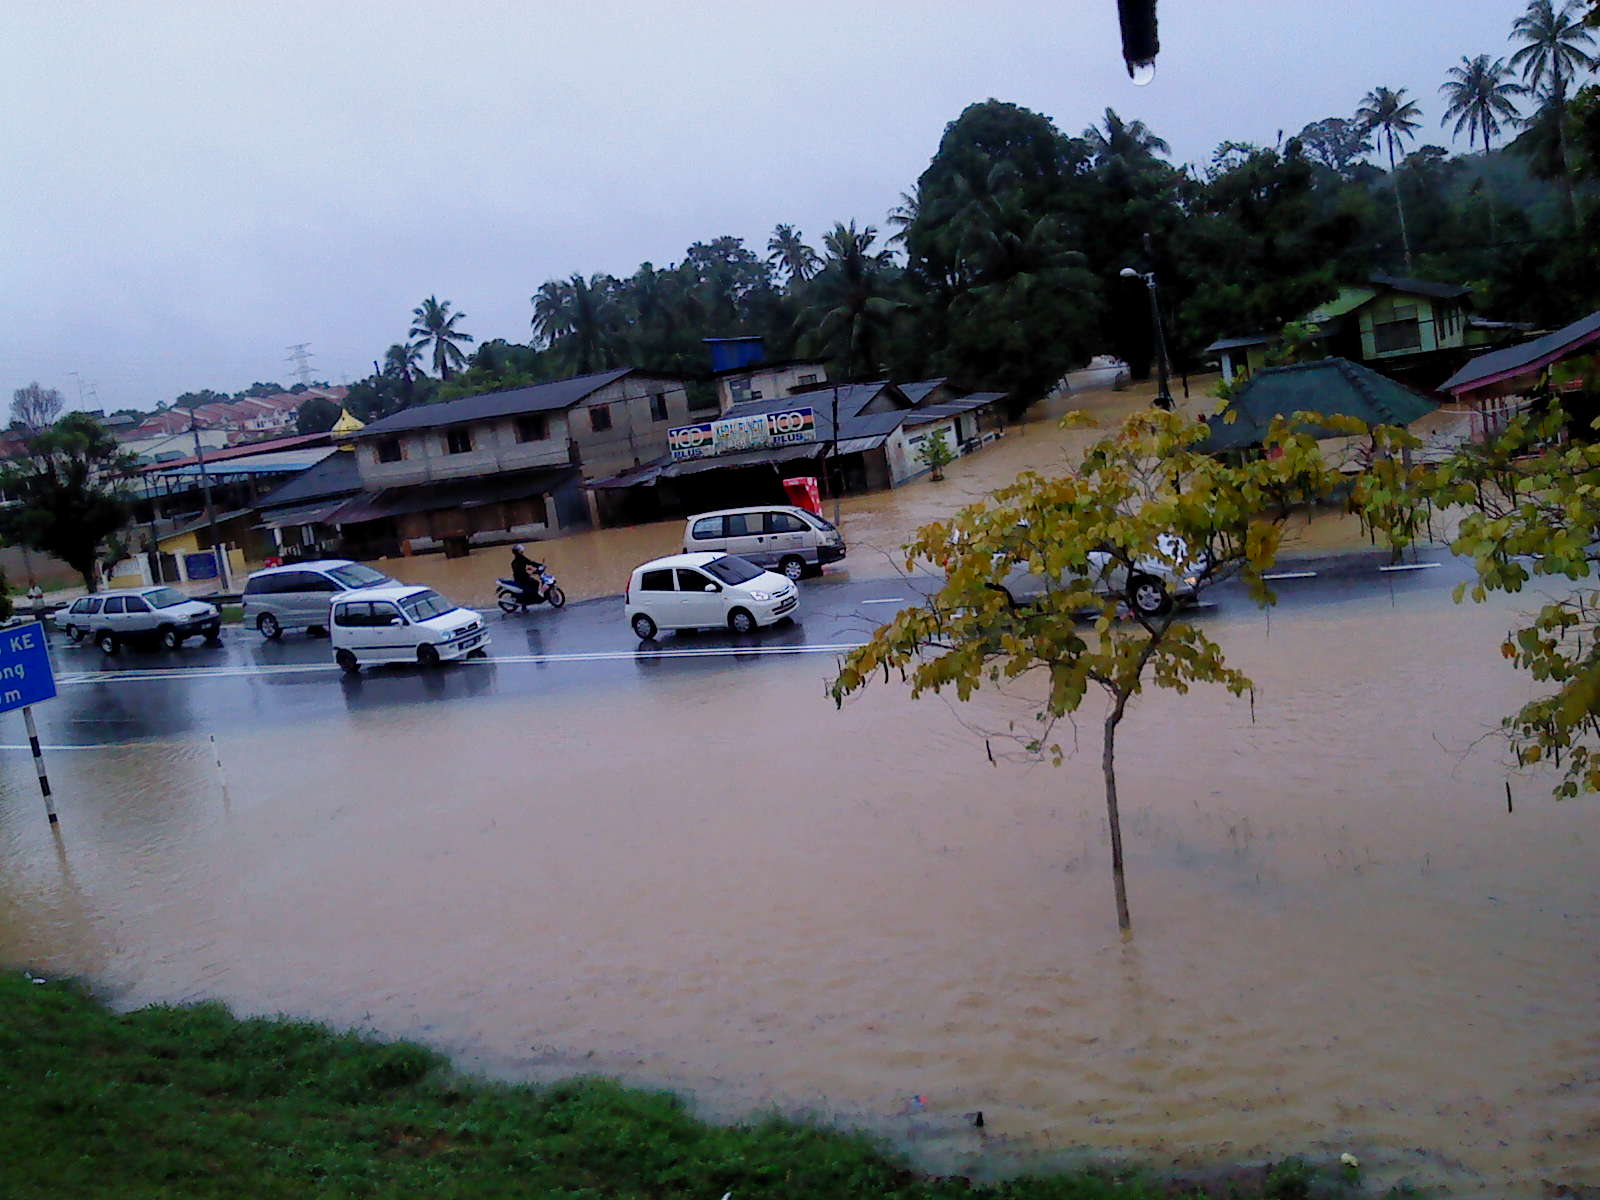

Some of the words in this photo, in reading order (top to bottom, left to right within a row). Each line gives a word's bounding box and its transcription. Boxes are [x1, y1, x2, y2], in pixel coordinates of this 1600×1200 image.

[770, 412, 804, 434] 100
[671, 428, 704, 450] 100
[773, 433, 803, 443] PLUS
[674, 450, 702, 459] PLUS
[10, 633, 35, 652] KE
[0, 690, 22, 704] m
